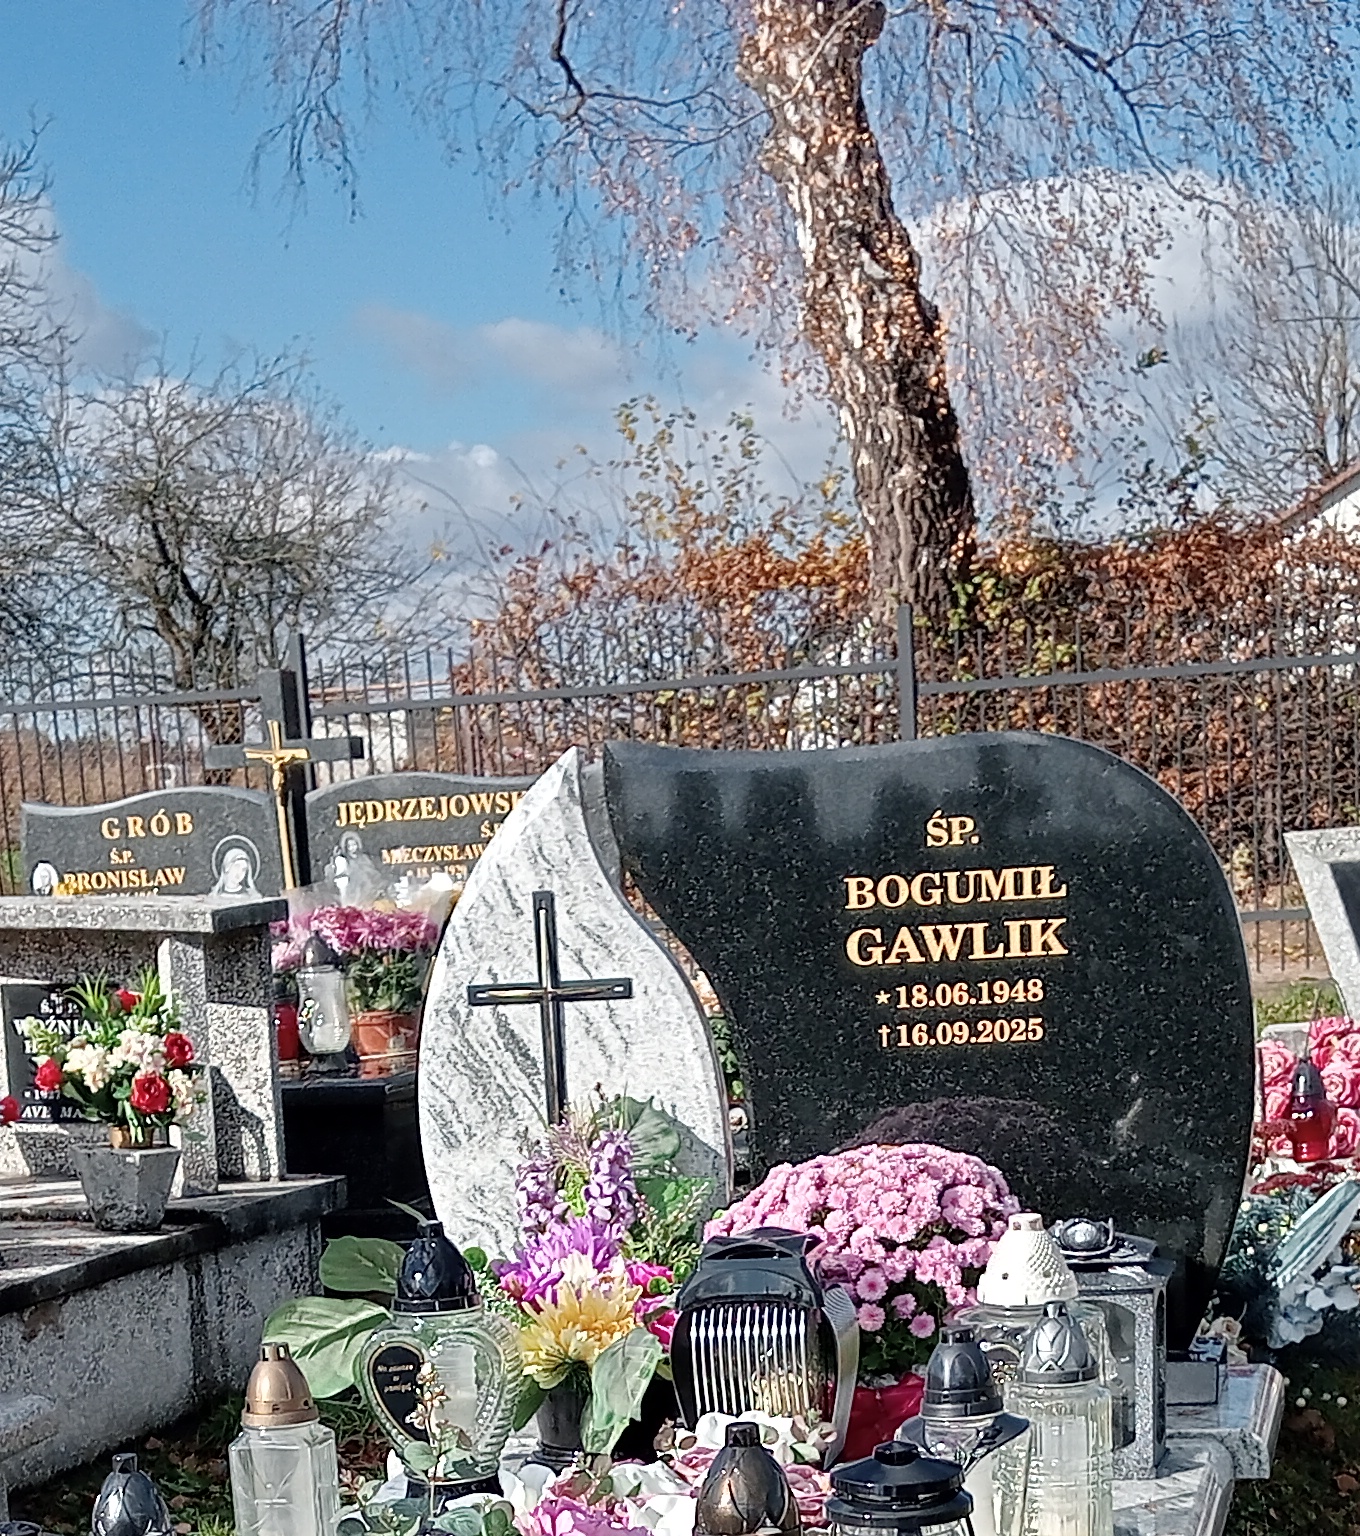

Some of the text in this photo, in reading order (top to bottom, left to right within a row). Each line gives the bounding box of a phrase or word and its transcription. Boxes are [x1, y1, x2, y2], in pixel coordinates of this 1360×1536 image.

[101, 808, 193, 840] GRÓB
[926, 810, 980, 847] ŚP.
[843, 865, 1068, 910] BOGUMIŁ
[845, 917, 1069, 967] GAWLIK
